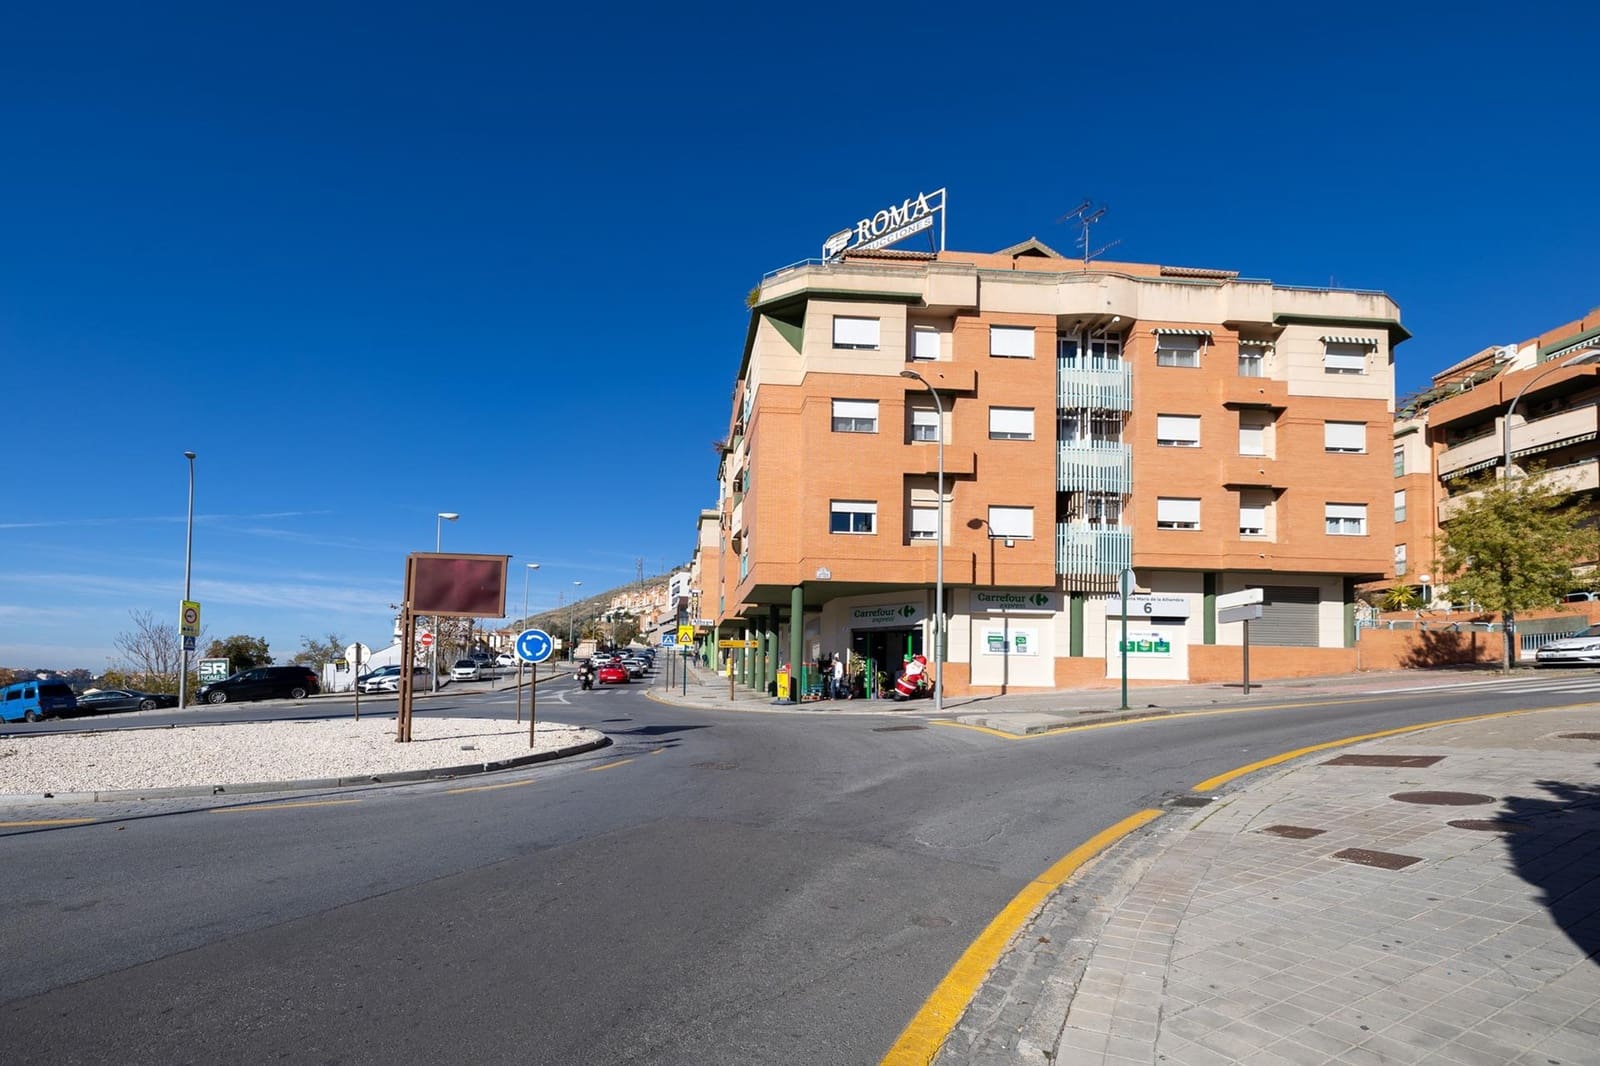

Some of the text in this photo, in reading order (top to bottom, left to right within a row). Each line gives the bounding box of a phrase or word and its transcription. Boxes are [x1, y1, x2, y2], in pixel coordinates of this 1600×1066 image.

[856, 192, 930, 245] ROMA
[977, 592, 1026, 602] Carrefour
[854, 607, 896, 618] Carrefour
[1143, 602, 1153, 614] 6
[200, 662, 226, 675] SR
